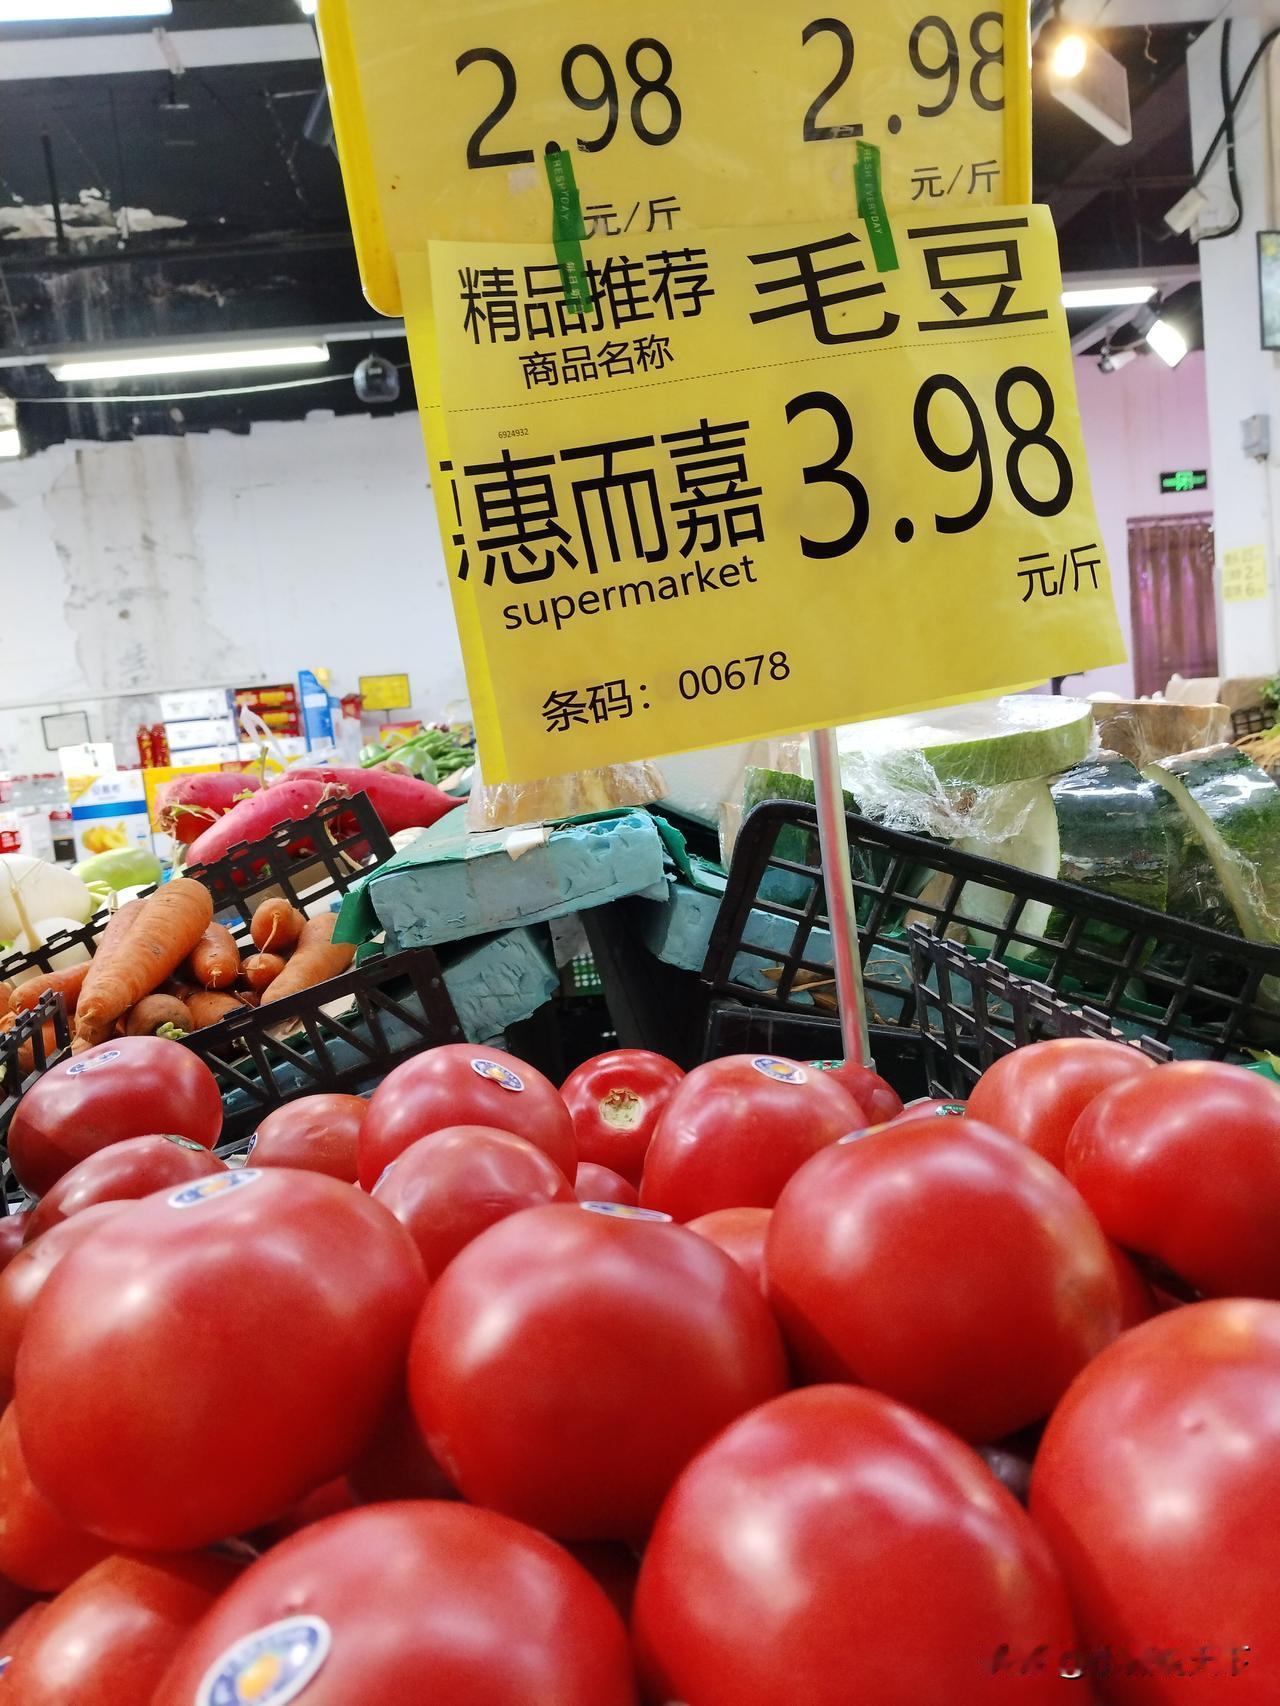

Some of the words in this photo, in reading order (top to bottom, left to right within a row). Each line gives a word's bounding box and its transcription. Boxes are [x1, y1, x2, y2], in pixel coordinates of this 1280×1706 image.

[456, 37, 682, 170] 2.98
[802, 12, 1004, 141] 2.98
[911, 159, 1001, 201] 元/斤
[583, 195, 682, 240] 元/斤
[458, 248, 715, 345] 精品推荐
[747, 218, 1049, 346] 毛豆
[518, 333, 675, 390] 商品名称
[498, 428, 529, 439] 6924932
[784, 365, 1074, 560] 3.98
[502, 554, 758, 631] supermarket
[1017, 543, 1102, 603] 元/斤
[678, 651, 791, 700] 00678
